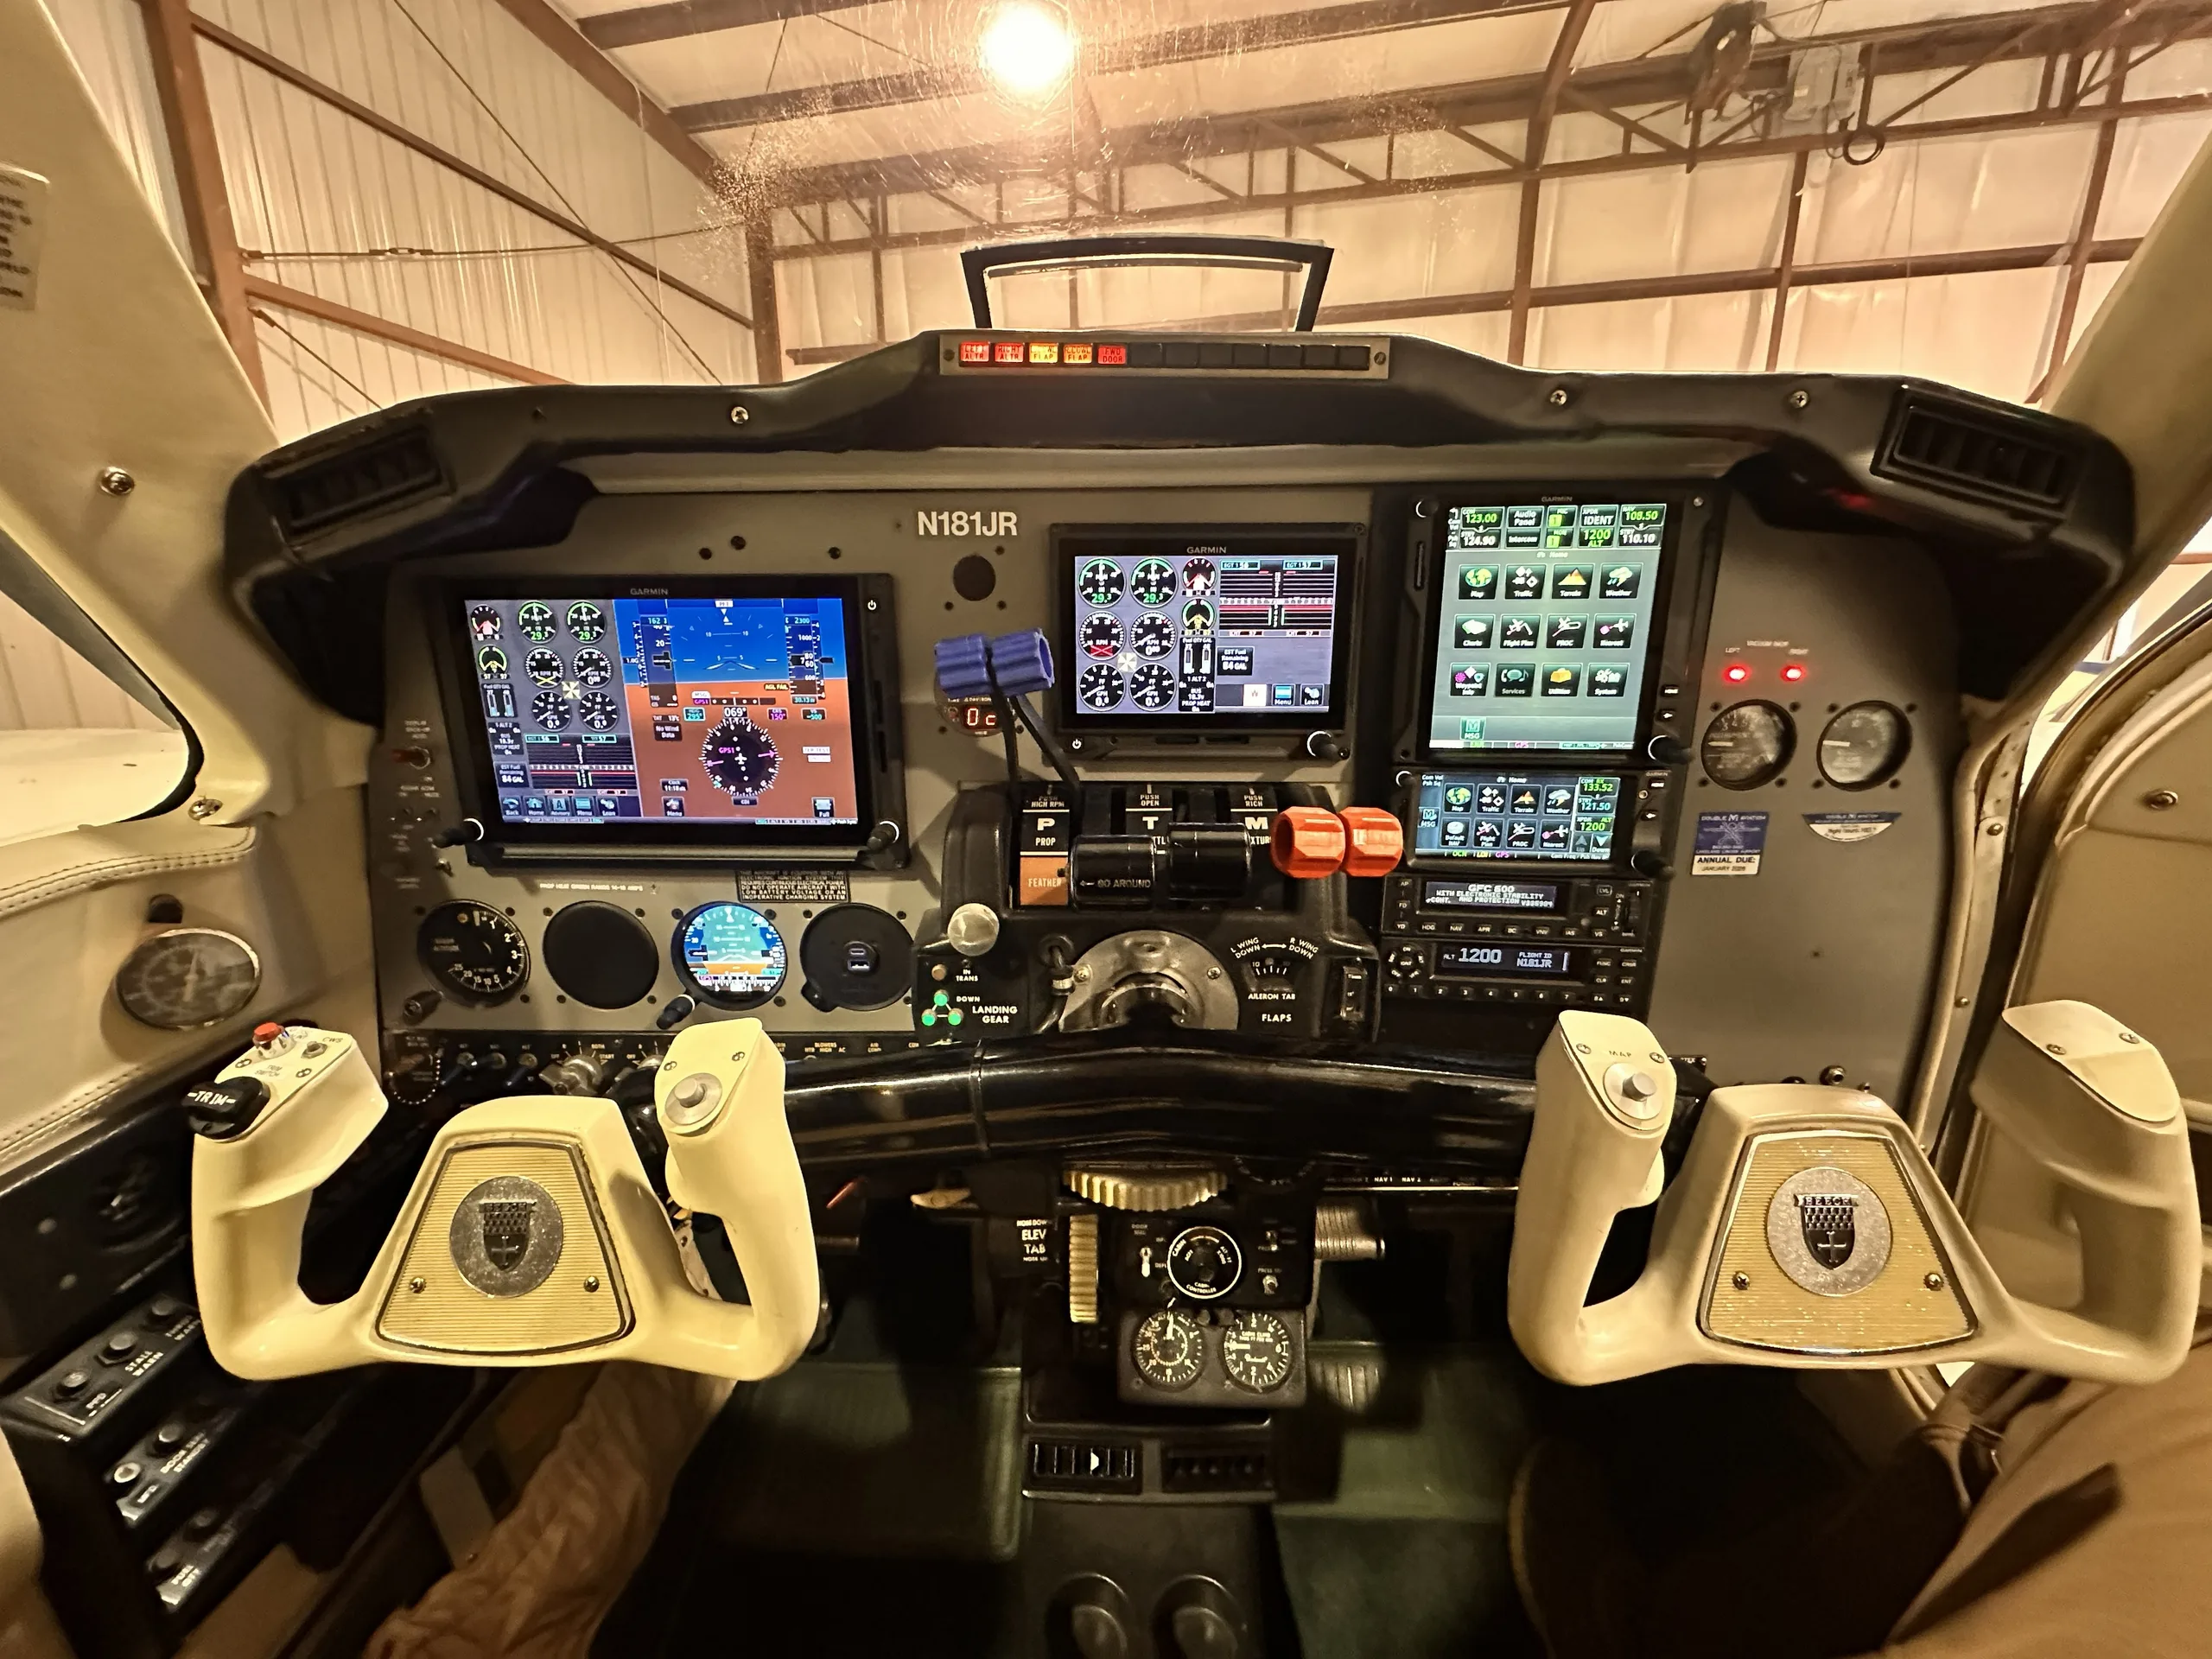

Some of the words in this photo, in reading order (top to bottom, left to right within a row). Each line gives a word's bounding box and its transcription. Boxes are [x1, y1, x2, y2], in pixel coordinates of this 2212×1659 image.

[964, 344, 985, 353] LEFT
[998, 344, 1020, 353] RIGHT
[1465, 513, 1497, 524] 123.00
[1583, 515, 1614, 525] IDENT
[1625, 511, 1658, 521] 108.50
[918, 512, 1018, 536] N181JR
[1583, 530, 1611, 540] 1200
[1623, 534, 1656, 543] 110.10
[1464, 536, 1496, 546] 124.90
[1091, 593, 1112, 603] 29.3
[1142, 593, 1163, 603] 29.3
[1583, 783, 1614, 791] 133.52
[1581, 802, 1611, 810] 121.50
[1037, 817, 1056, 831] P
[1142, 816, 1159, 830] T
[1244, 817, 1268, 830] M
[1580, 823, 1605, 831] 1200
[1035, 837, 1056, 847] PROP
[1028, 878, 1062, 887] FEATHER
[1113, 879, 1151, 888] AROUND
[489, 920, 496, 930] 1
[505, 933, 512, 942] 2
[1237, 937, 1260, 950] WING
[1299, 938, 1319, 954] WING
[511, 950, 518, 959] 3
[1235, 945, 1261, 959] DOWN
[1289, 945, 1313, 959] DOWN
[1459, 947, 1503, 964] 1200
[1516, 957, 1552, 968] N181JR
[506, 966, 512, 975] 4
[493, 974, 499, 983] 5
[972, 1006, 1018, 1014] LANDING
[1262, 1014, 1292, 1022] FLAPS
[1806, 1196, 1850, 1206] BEECH
[1021, 1229, 1046, 1241] ELEV
[1023, 1243, 1046, 1255] TAB
[1172, 1239, 1187, 1256] CABIN
[1185, 1284, 1217, 1294] CONTROLLER
[124, 1351, 153, 1372] STALL
[132, 1351, 164, 1376] WARN
